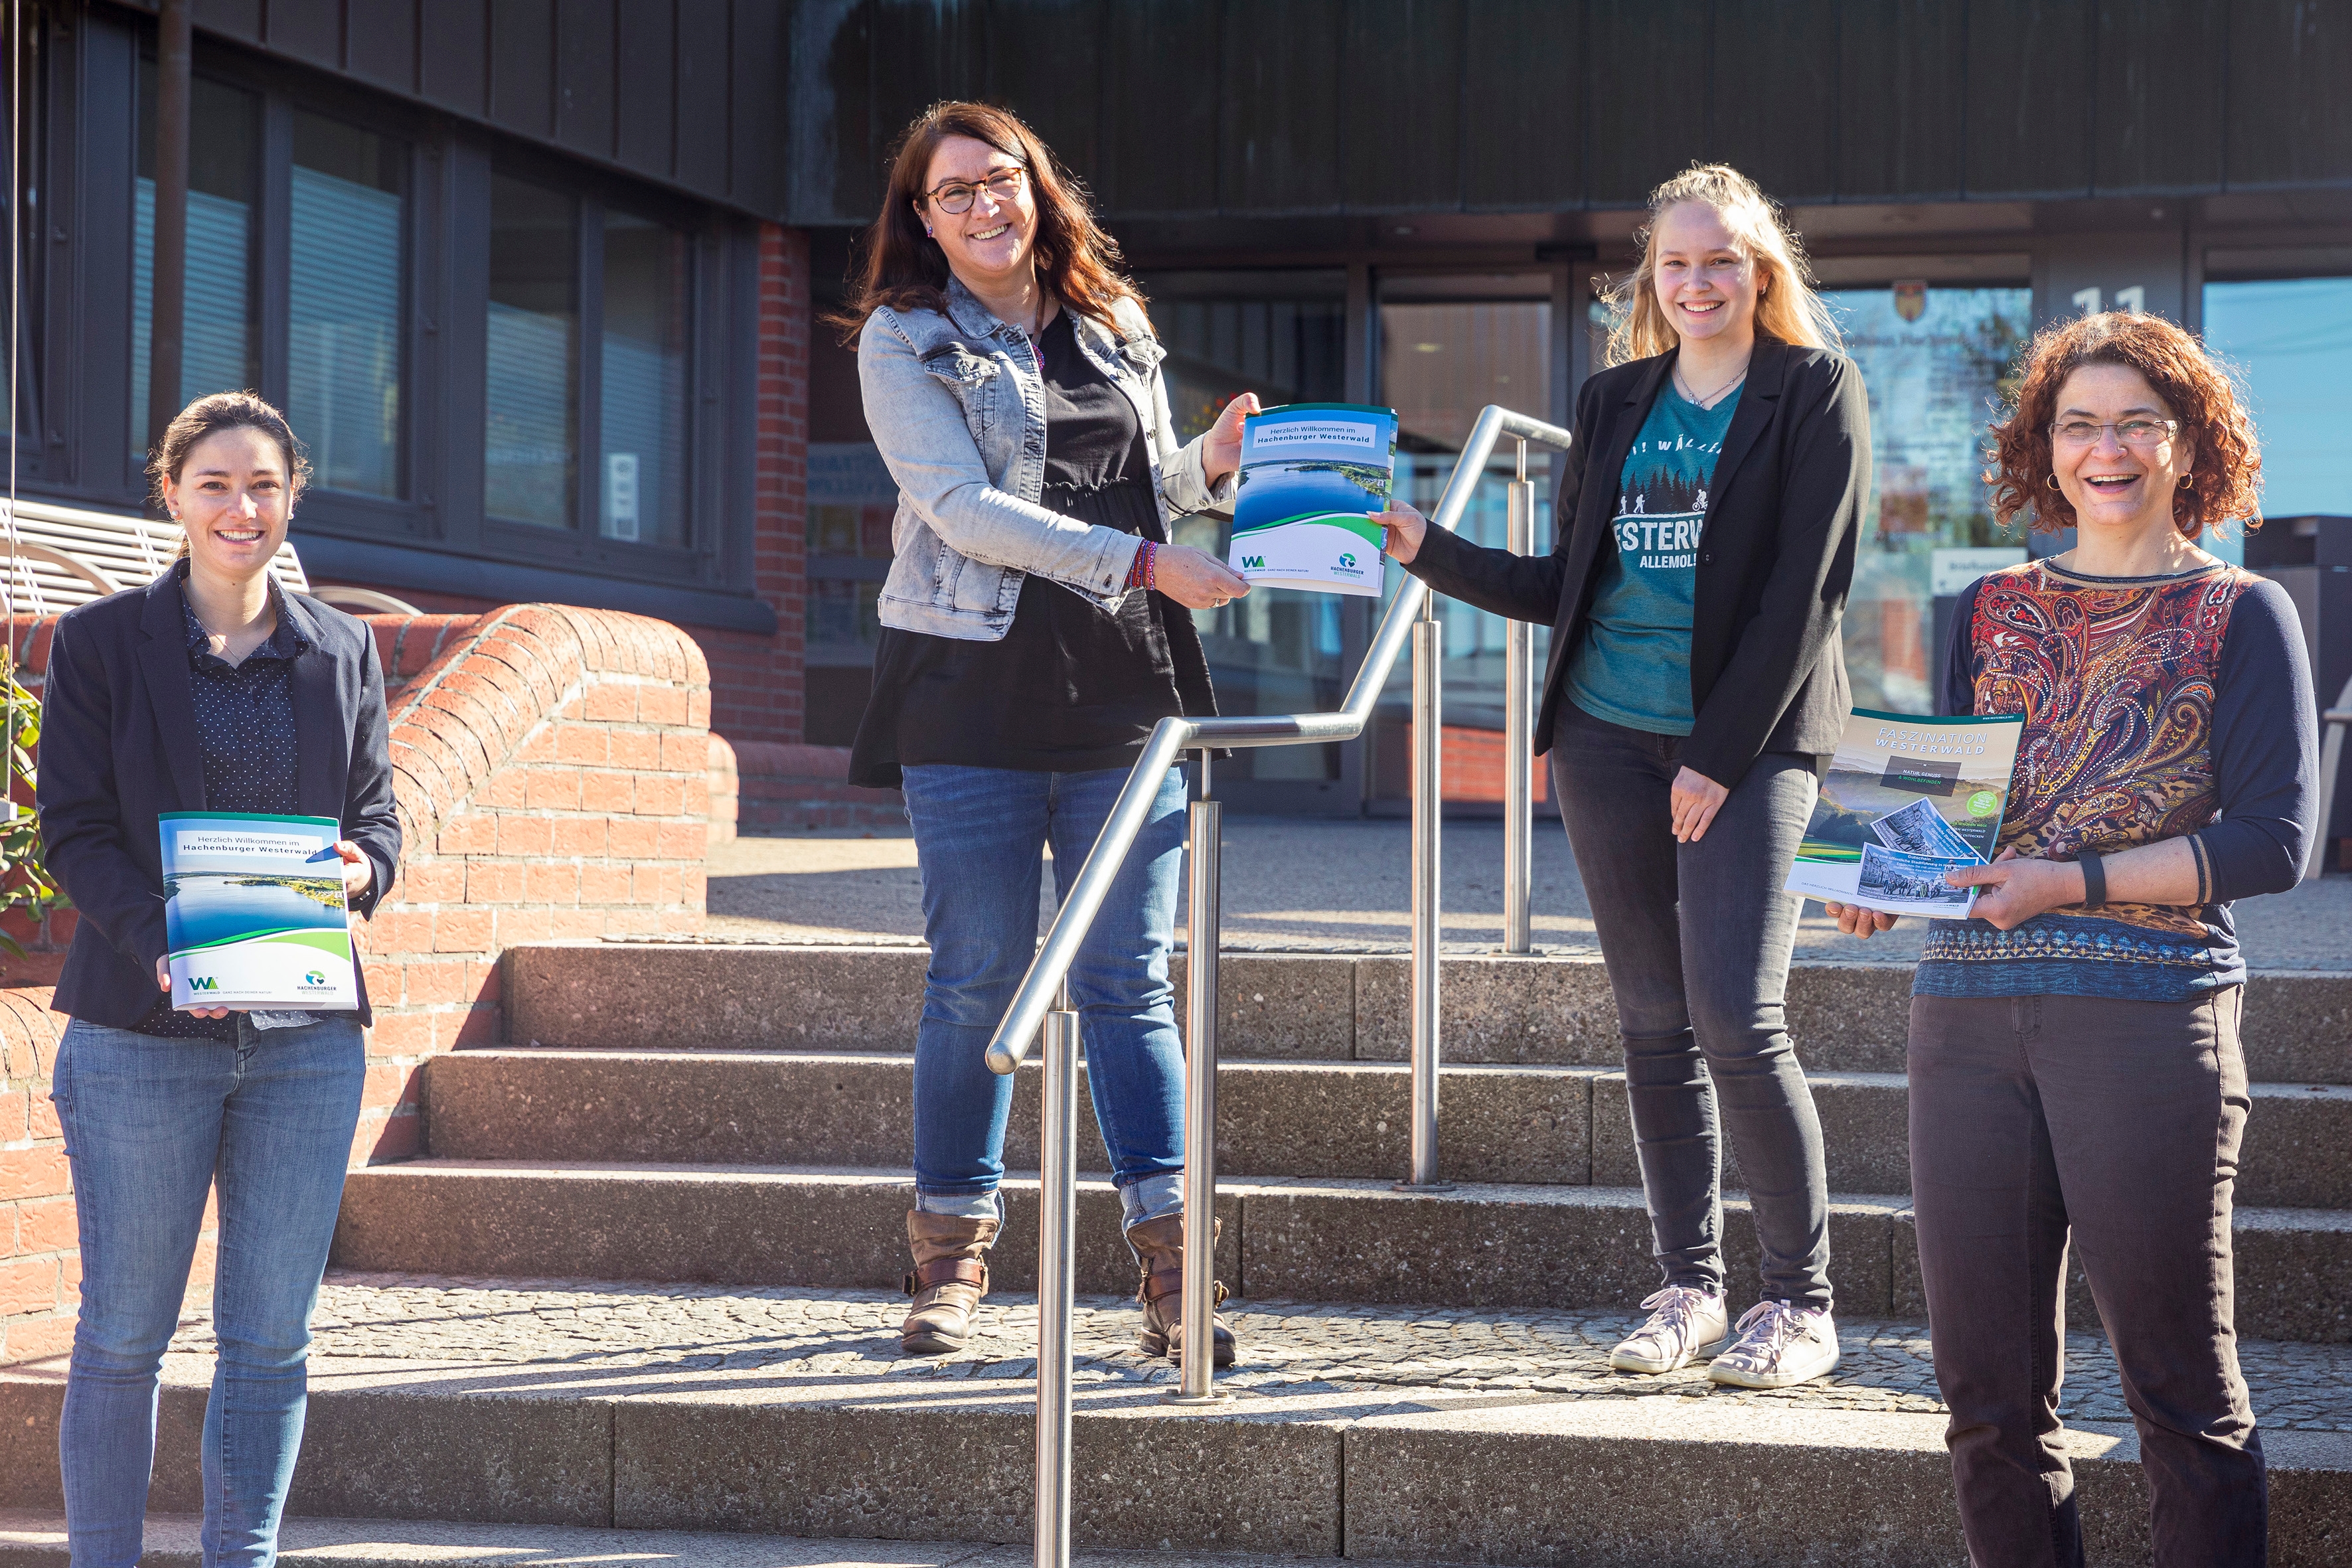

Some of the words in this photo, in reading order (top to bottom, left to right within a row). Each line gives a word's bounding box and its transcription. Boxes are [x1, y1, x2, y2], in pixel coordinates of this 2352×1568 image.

[1270, 426, 1299, 435] Herzlich
[1257, 434, 1316, 443] Hachenburger
[1320, 433, 1370, 443] Westerwald
[1640, 553, 1697, 568] ALLEMOL!
[1330, 566, 1364, 575] HACHENBURGER
[1879, 727, 1988, 744] FASZINATION
[1875, 738, 1986, 755] WESTERWALD
[1903, 775, 1942, 785] WOHLBEFINDEN
[1946, 828, 1961, 843] Gutschein
[234, 837, 287, 846] Willkommen
[259, 846, 317, 856] Westerwald
